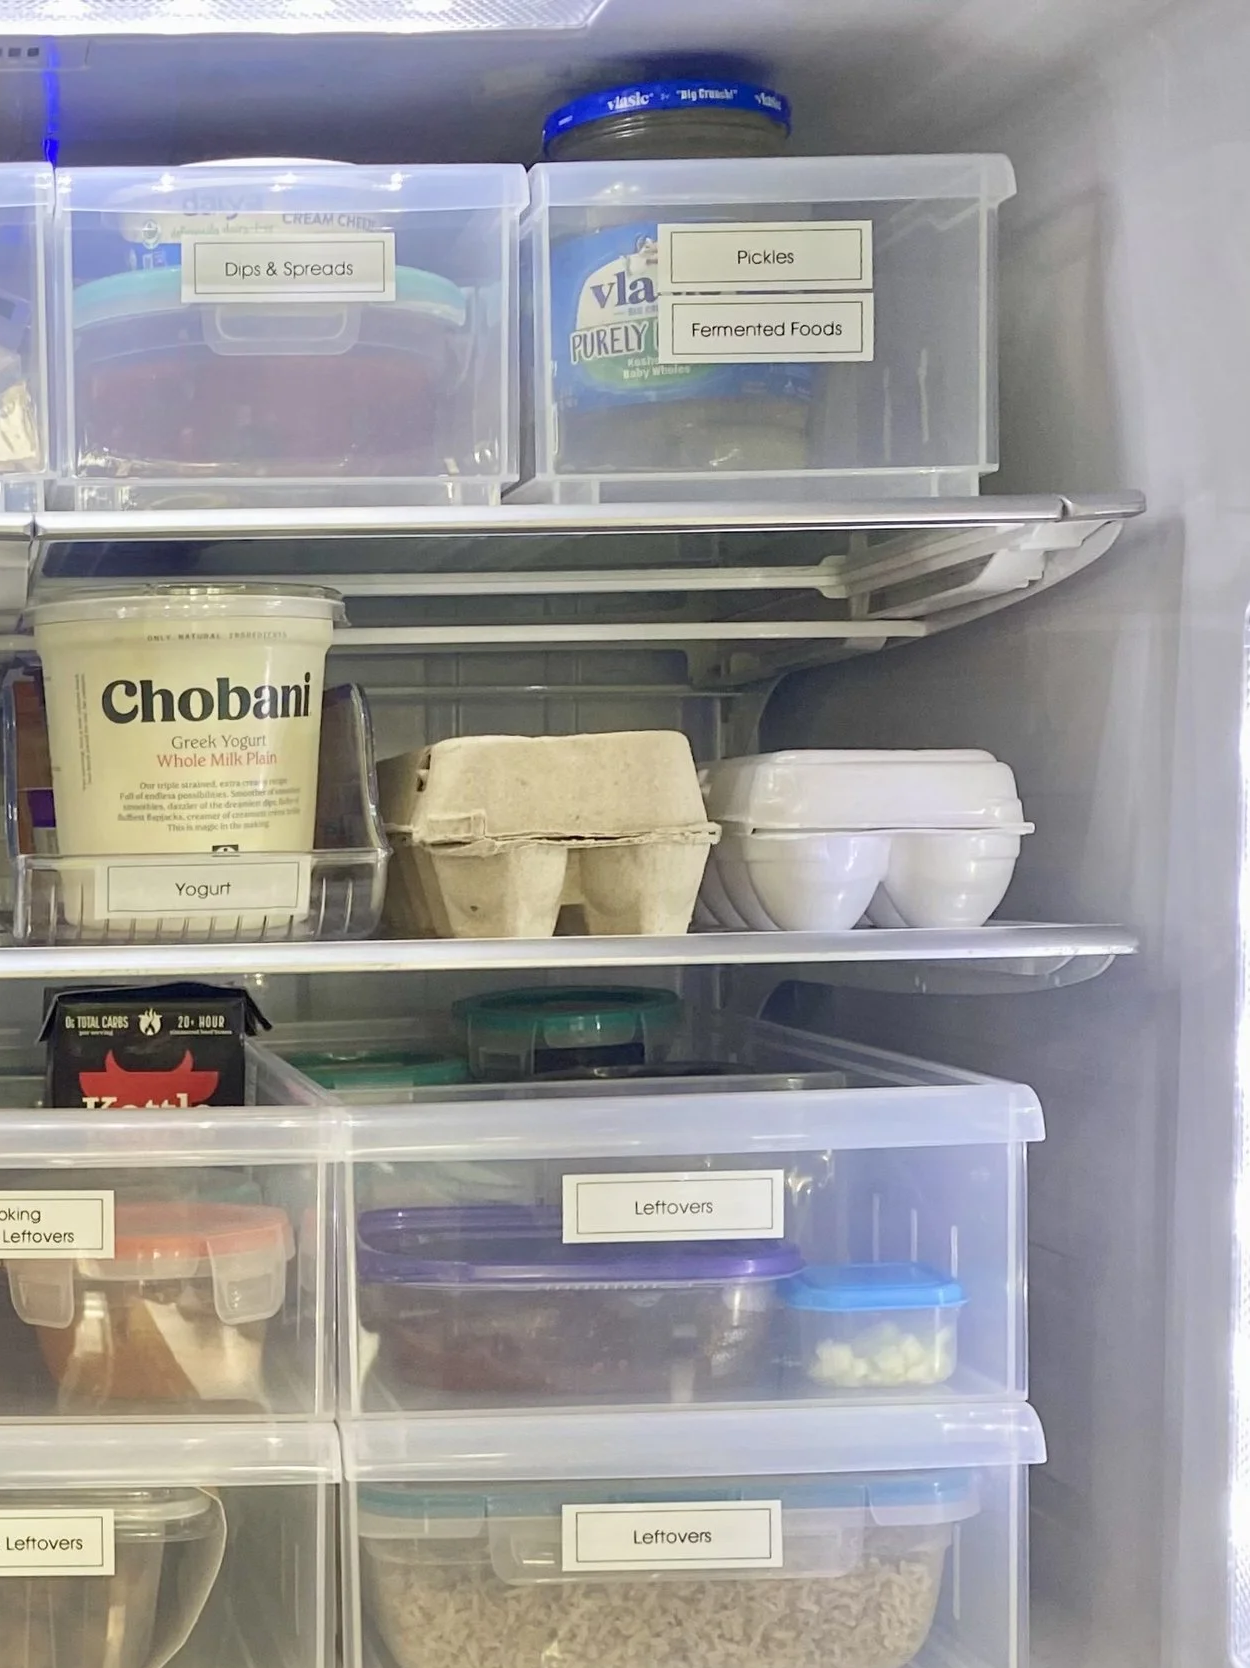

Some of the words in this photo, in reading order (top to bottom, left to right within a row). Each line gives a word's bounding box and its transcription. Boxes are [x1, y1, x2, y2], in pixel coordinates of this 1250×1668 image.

[607, 91, 649, 111] vlasic
[283, 212, 334, 226] CREAM
[737, 249, 795, 265] Pickles
[225, 262, 261, 279] Dips
[265, 262, 277, 276] &
[283, 261, 354, 278] Spreads
[590, 270, 658, 309] vla
[691, 322, 785, 338] Fermented
[790, 321, 843, 337] Foods
[571, 322, 647, 363] PURELY
[622, 367, 649, 380] Baby
[147, 633, 171, 642] ONLY
[178, 632, 221, 641] NATURAL
[101, 671, 311, 724] Chobani
[171, 735, 217, 750] Greek
[221, 734, 267, 752] Yogurt
[156, 754, 206, 768] Whole
[211, 752, 242, 767] Milk
[246, 752, 277, 766] Plain
[167, 823, 185, 832] This
[175, 882, 231, 899] Yogurt
[77, 1016, 100, 1029] TOTAL
[102, 1016, 129, 1029] CARBS
[199, 1015, 224, 1028] HOUR
[635, 1200, 713, 1215] Leftovers
[2, 1230, 75, 1244] Leftovers
[6, 1536, 83, 1551] Leftovers
[633, 1530, 712, 1544] Leftovers
